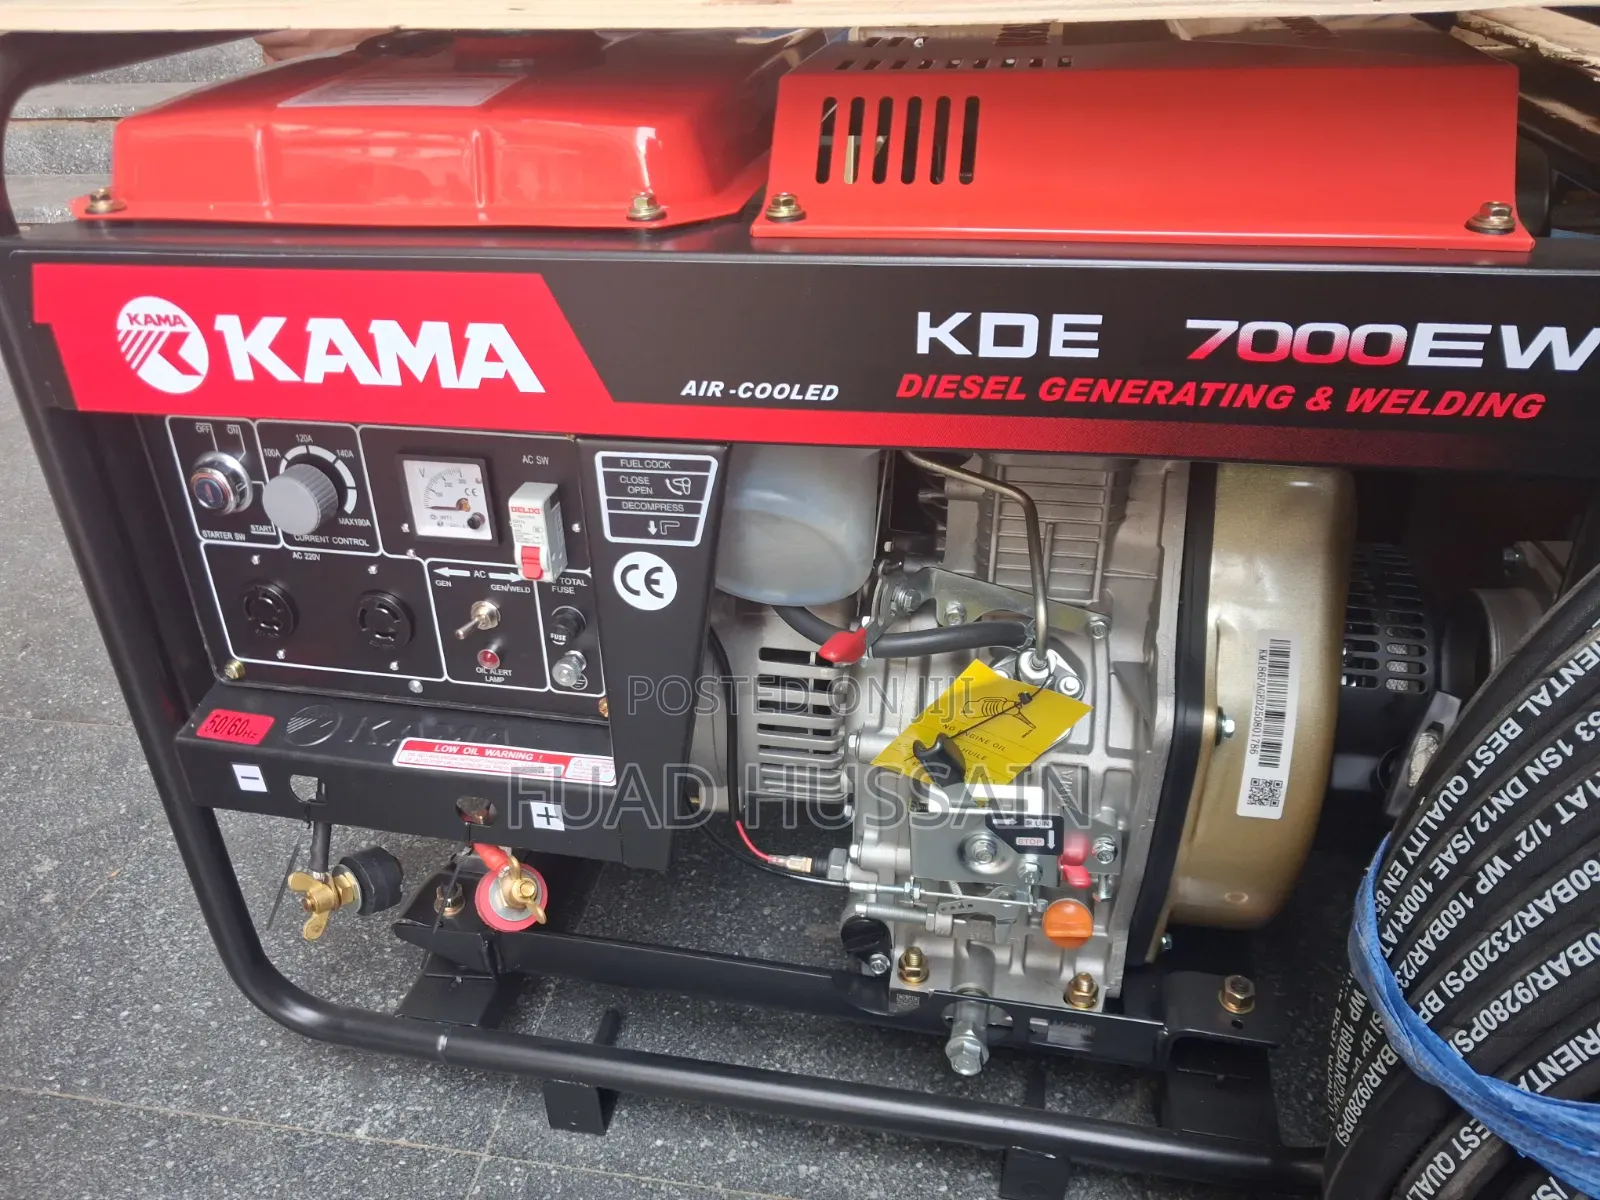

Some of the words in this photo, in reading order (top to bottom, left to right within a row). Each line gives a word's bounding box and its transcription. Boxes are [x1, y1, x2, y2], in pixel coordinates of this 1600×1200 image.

[127, 312, 187, 328] KAMA
[916, 311, 1103, 358] KDE
[1185, 319, 1600, 371] 7000EW
[214, 314, 546, 393] KAMA
[681, 380, 723, 397] AIR
[896, 373, 1024, 400] DIESEL
[1038, 376, 1296, 410] GENERATING
[1305, 386, 1334, 411] &
[1346, 388, 1546, 419] WELDING
[196, 424, 210, 433] OFF
[228, 425, 239, 434] ON
[296, 434, 313, 443] 120A
[264, 449, 280, 457] 100A
[337, 449, 354, 458] 140A
[522, 455, 534, 465] AC
[536, 456, 550, 465] SW
[620, 459, 643, 469] FUEL
[645, 460, 671, 469] COCK
[620, 475, 650, 485] CLOSE
[628, 485, 653, 495] OPEN
[622, 501, 684, 512] DECOMPRESS
[202, 530, 233, 540] STARTER
[235, 533, 246, 541] SW
[294, 534, 330, 544] CURRENT
[332, 537, 370, 547] CONTROL
[293, 552, 303, 560] AC
[474, 570, 486, 579] AC
[560, 577, 587, 587] TOTAL
[620, 563, 665, 599] CE
[435, 579, 452, 587] GEN
[490, 584, 531, 594] GEN/WELD
[552, 586, 575, 595] FUSE
[550, 632, 567, 642] FUSE
[476, 667, 488, 675] OIL
[490, 668, 512, 677] ALERT
[943, 723, 956, 732] NO
[957, 729, 991, 746] ENGINE
[992, 742, 1006, 752] OIL
[434, 744, 460, 754] LOW
[463, 746, 479, 756] OIL
[485, 748, 534, 761] WARNING
[1466, 718, 1523, 778] BEST
[1524, 739, 1573, 783] 1SN
[1470, 776, 1528, 832] DN12
[1555, 771, 1600, 824] 1AT
[1024, 819, 1051, 828] RUN
[1402, 776, 1468, 864] QUALITY
[1016, 837, 1043, 846] STOP
[1429, 826, 1475, 880] /SAE
[1383, 860, 1408, 893] EN
[1476, 856, 1512, 894] WP
[1374, 890, 1391, 924] 85
[1440, 852, 1600, 998] 60BAR/2320PSI
[1394, 892, 1474, 996] 160BAR/23
[1448, 927, 1600, 1058] 0BAR/9280PSI
[1349, 988, 1367, 1022] WP
[1452, 1118, 1492, 1160] EST
[1406, 1151, 1456, 1200] QUAL
[1530, 1176, 1568, 1200] /S
